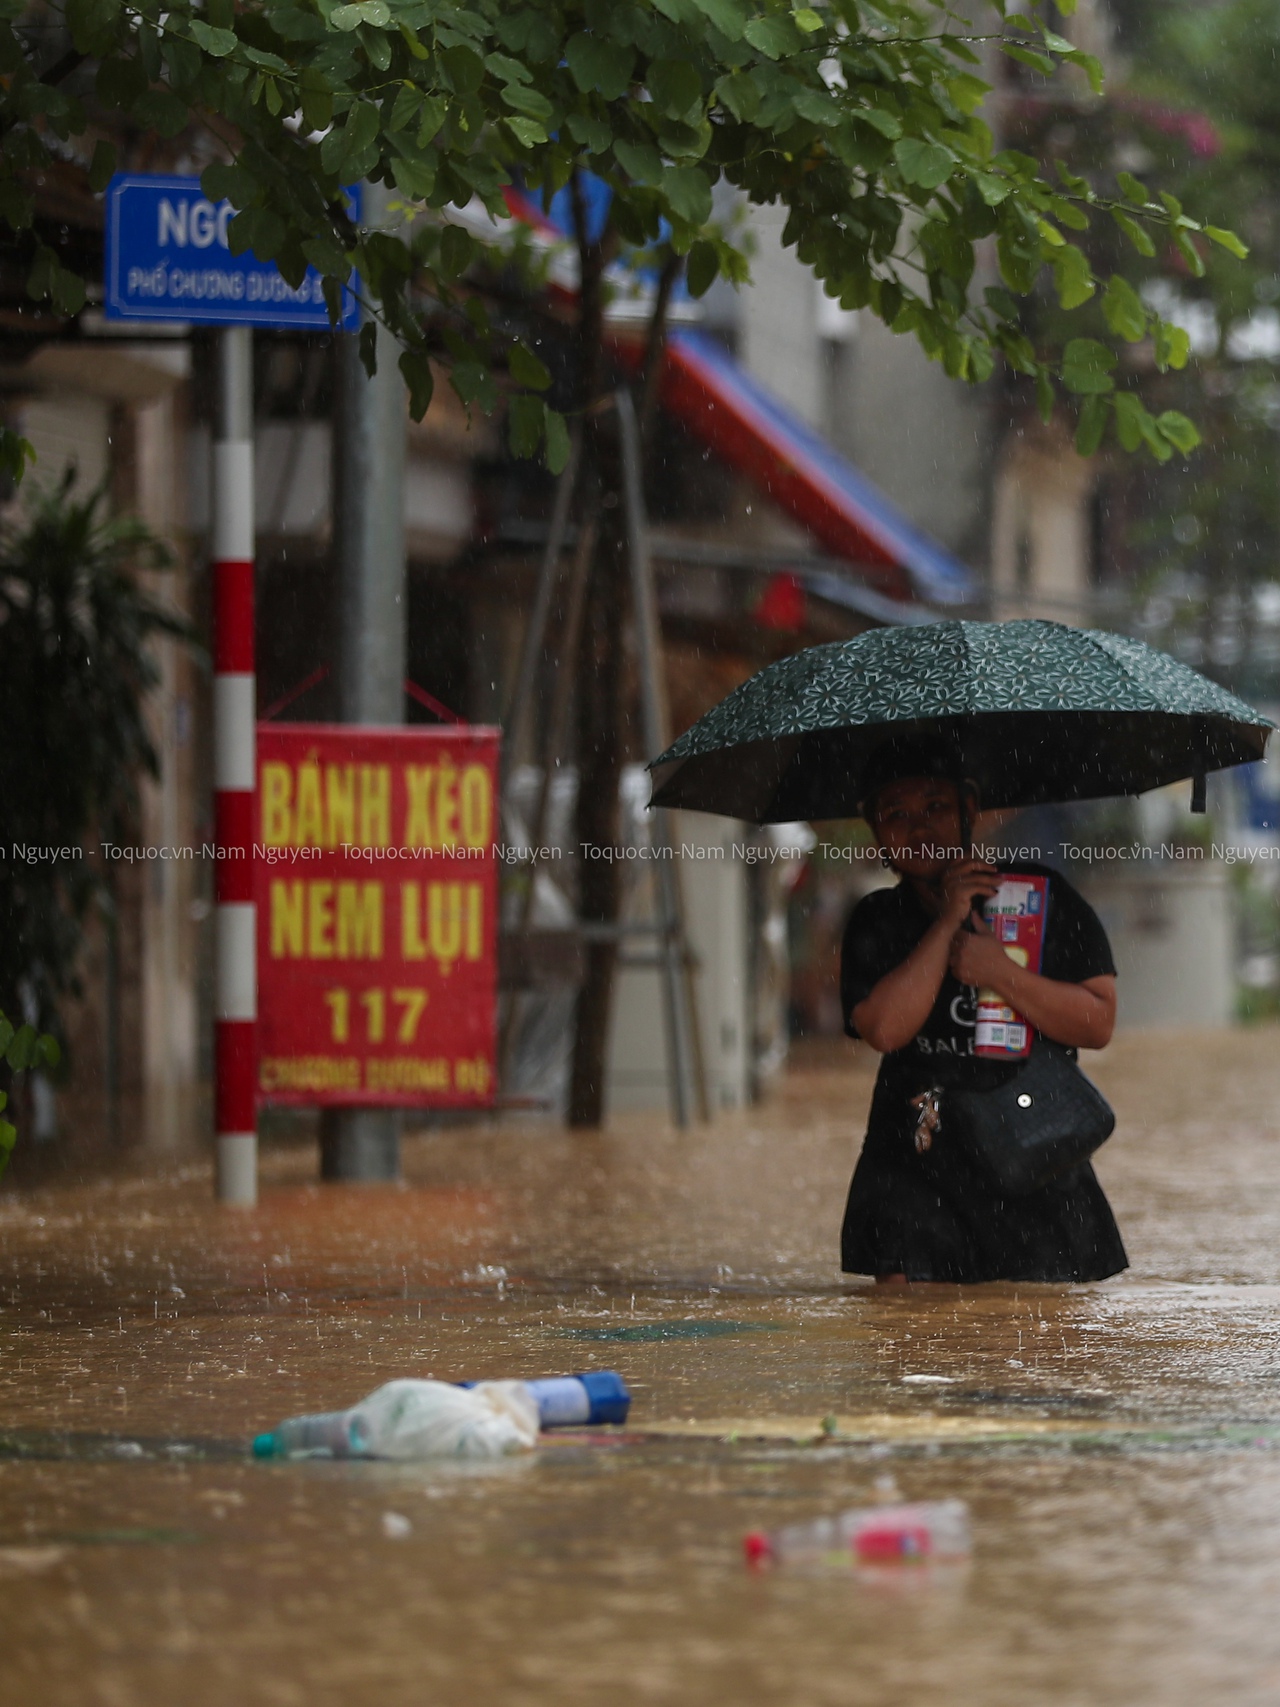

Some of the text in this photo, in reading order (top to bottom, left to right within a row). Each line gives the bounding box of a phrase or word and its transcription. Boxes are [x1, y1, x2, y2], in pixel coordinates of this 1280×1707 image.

[261, 749, 493, 849] BÁNH XÈO
[270, 880, 482, 977] NEM LỤI
[324, 986, 428, 1044] 117
